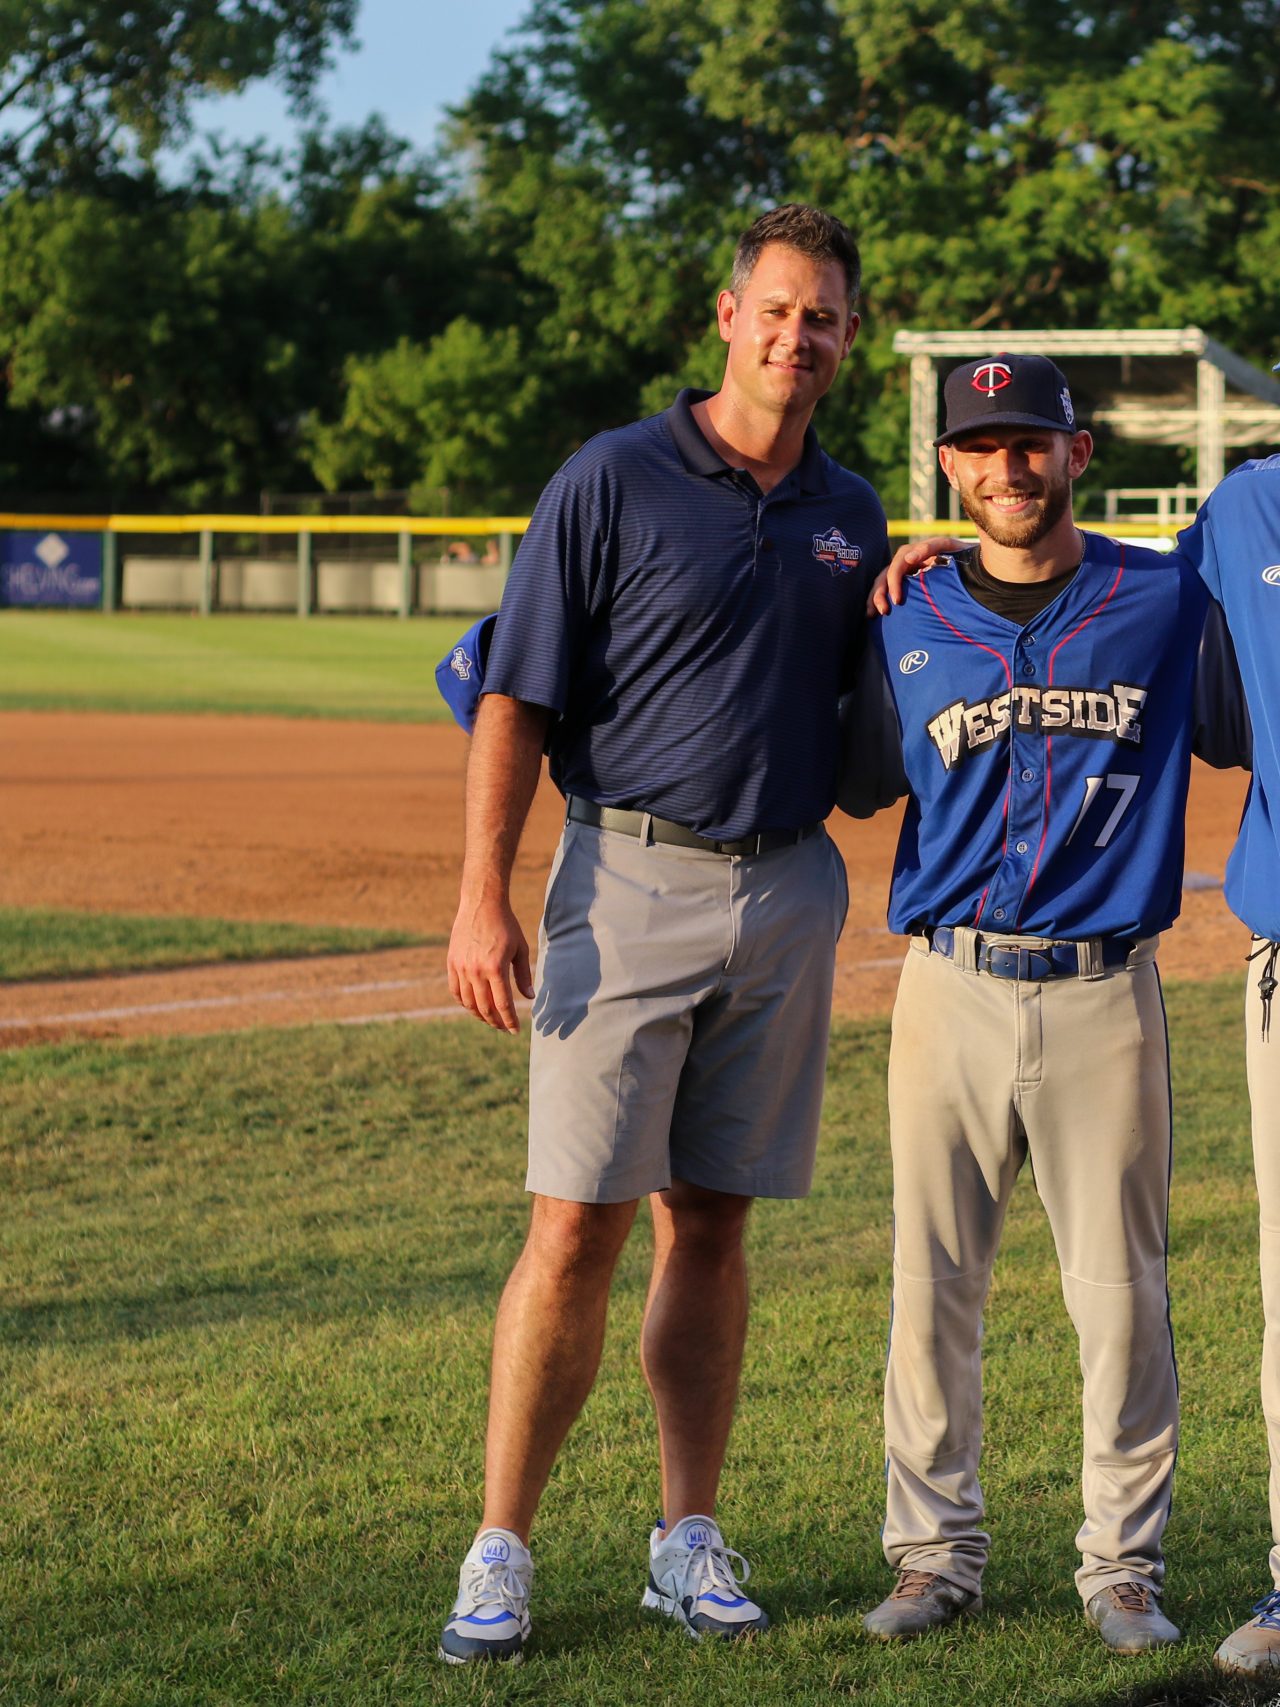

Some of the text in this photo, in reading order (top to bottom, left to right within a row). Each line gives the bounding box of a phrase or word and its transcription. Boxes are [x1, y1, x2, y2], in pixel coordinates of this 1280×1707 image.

[815, 538, 841, 552] UNITED
[837, 548, 860, 560] SHORE
[927, 683, 1148, 770] WESTSIDE
[1065, 773, 1141, 847] 17
[690, 1530, 707, 1543] MAX
[486, 1543, 505, 1559] MAX
